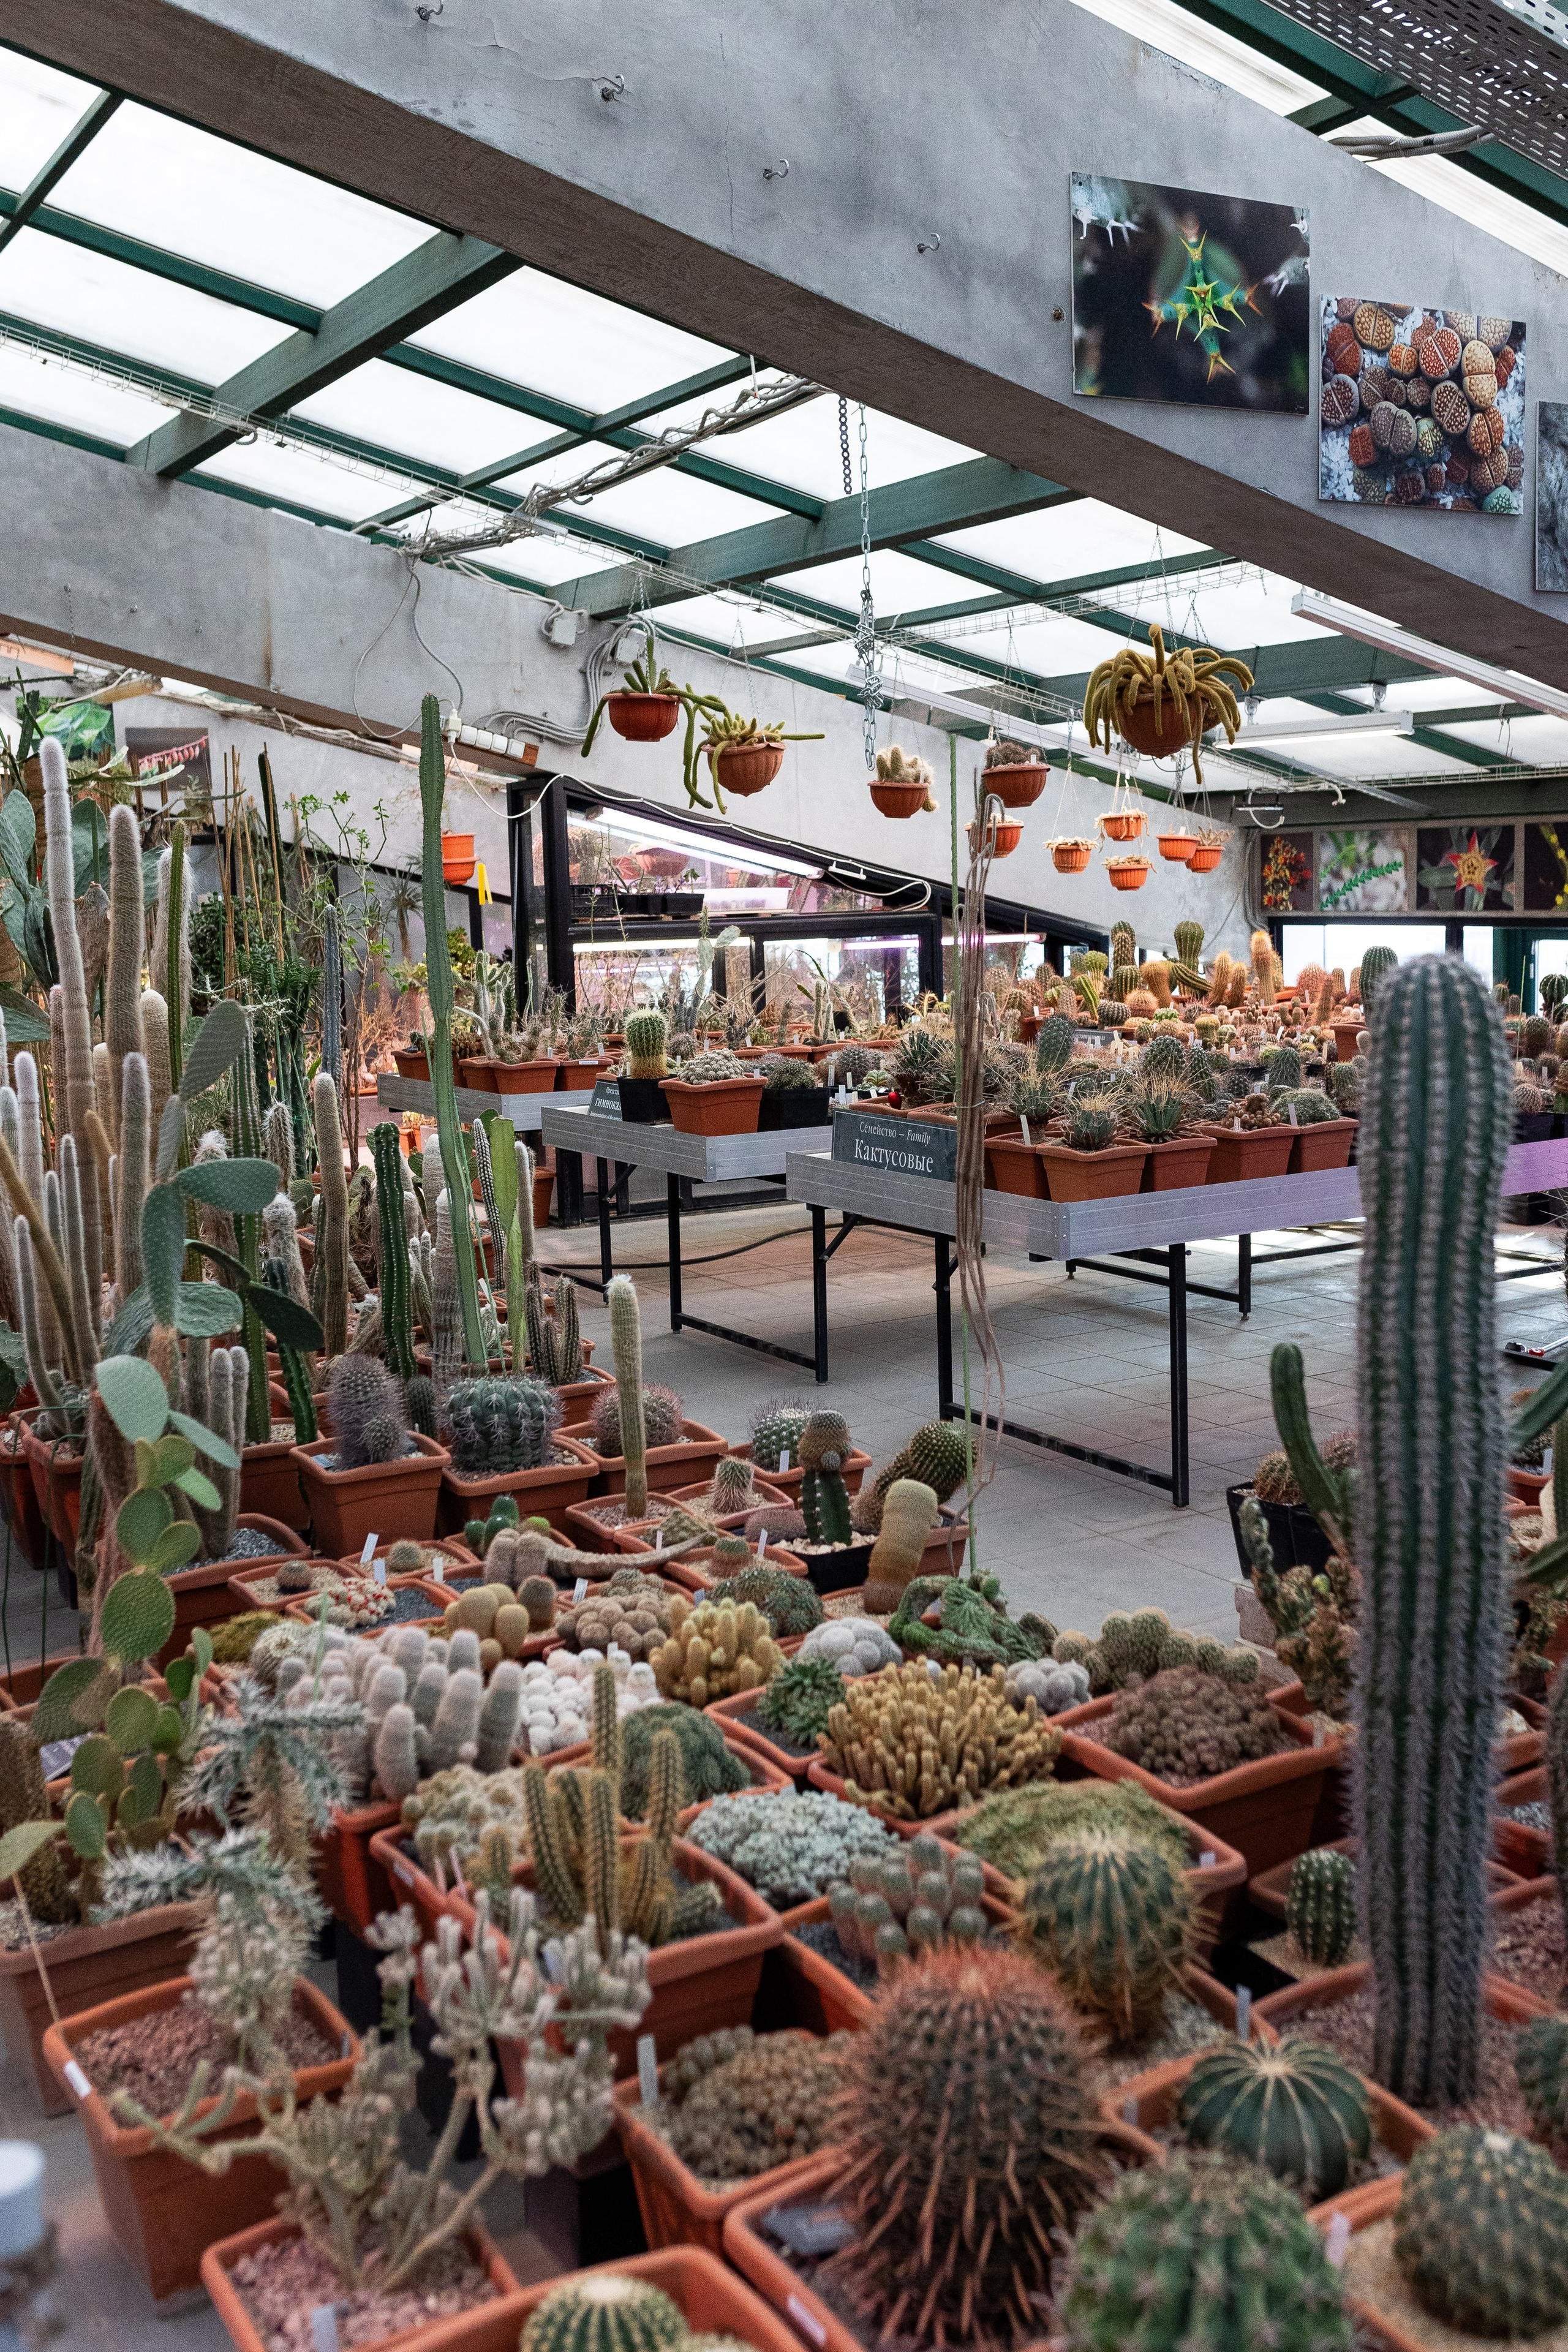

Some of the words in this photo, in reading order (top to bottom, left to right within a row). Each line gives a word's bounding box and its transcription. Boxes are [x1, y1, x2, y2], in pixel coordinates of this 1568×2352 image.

[859, 1121, 897, 1138] Семейство
[907, 1129, 931, 1147] Family
[854, 1139, 933, 1172] Кактусовые
